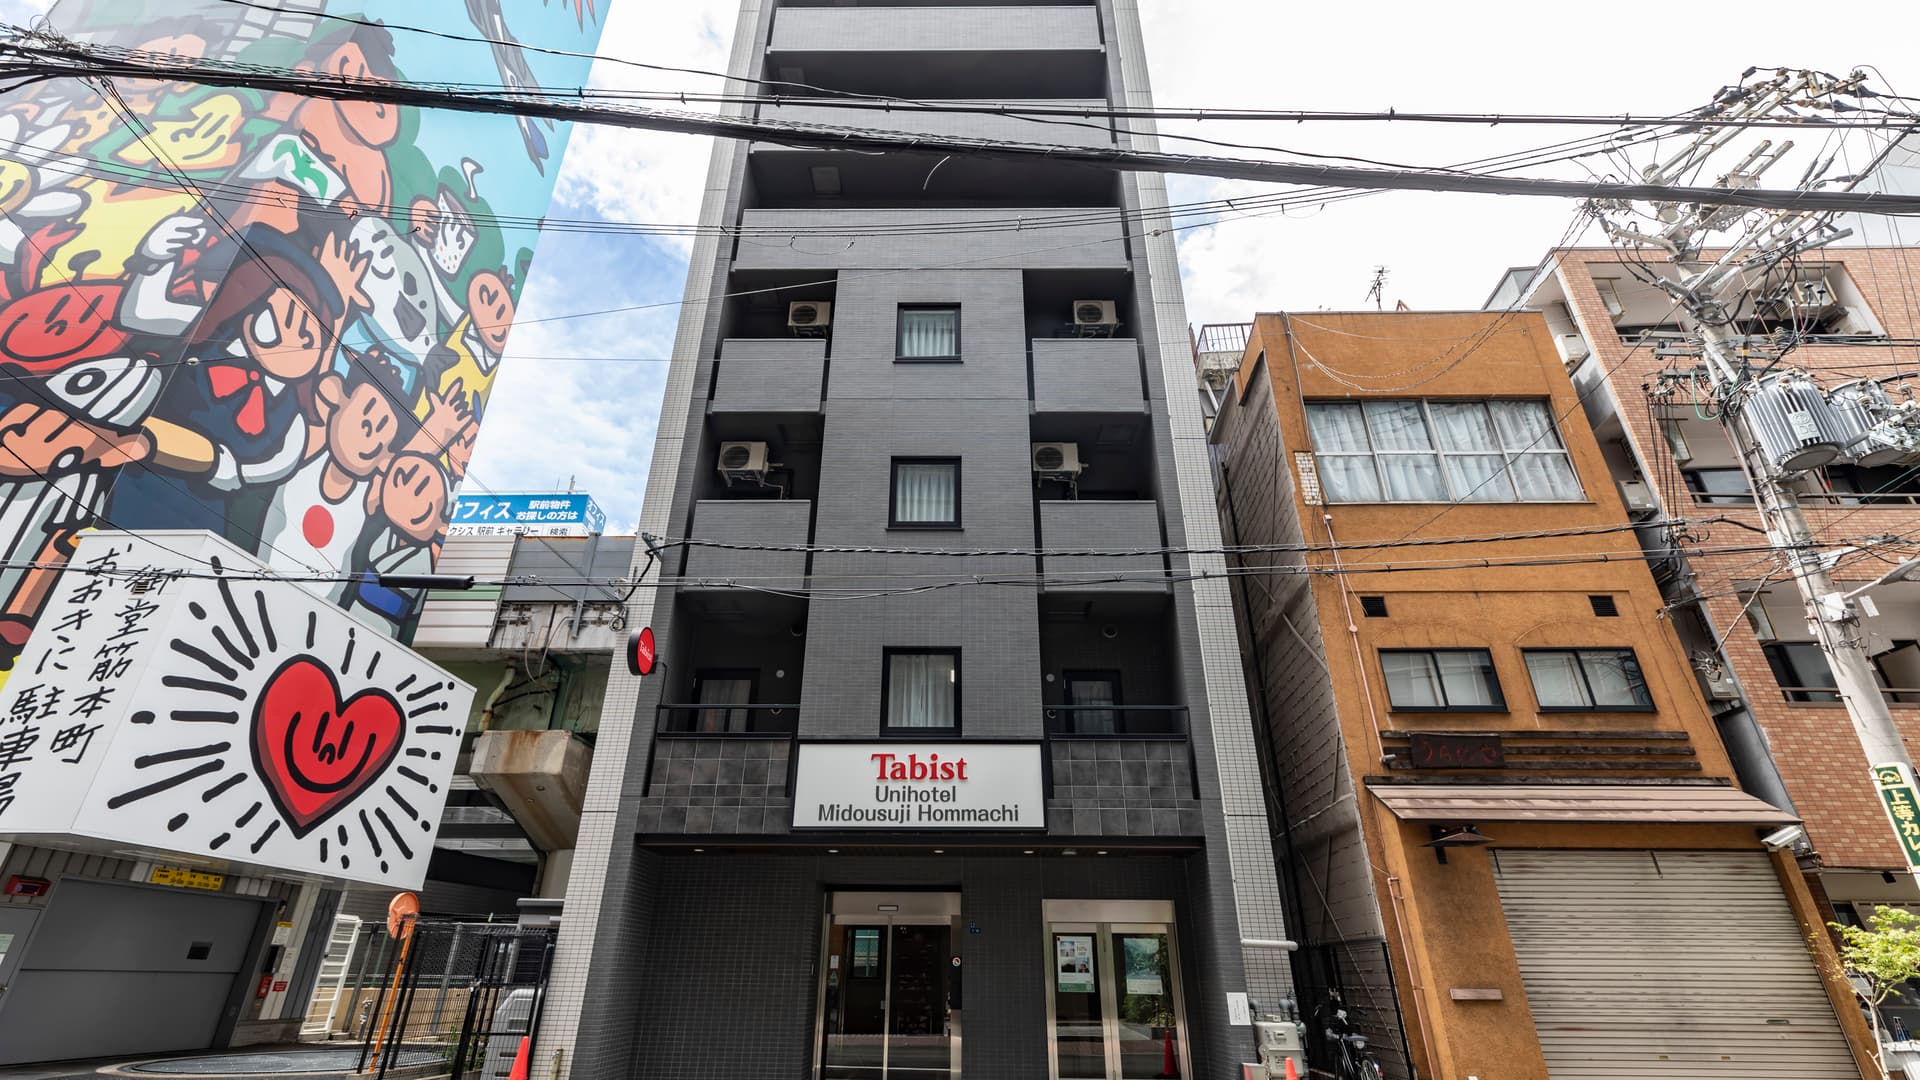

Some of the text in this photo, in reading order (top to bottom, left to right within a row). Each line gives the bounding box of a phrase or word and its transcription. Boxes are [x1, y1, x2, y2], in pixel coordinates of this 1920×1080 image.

[515, 511, 578, 521] お探しの方は
[871, 753, 968, 781] Tabist
[875, 785, 956, 802] Unihotel
[818, 804, 1019, 824] Midousuji Hommachi
